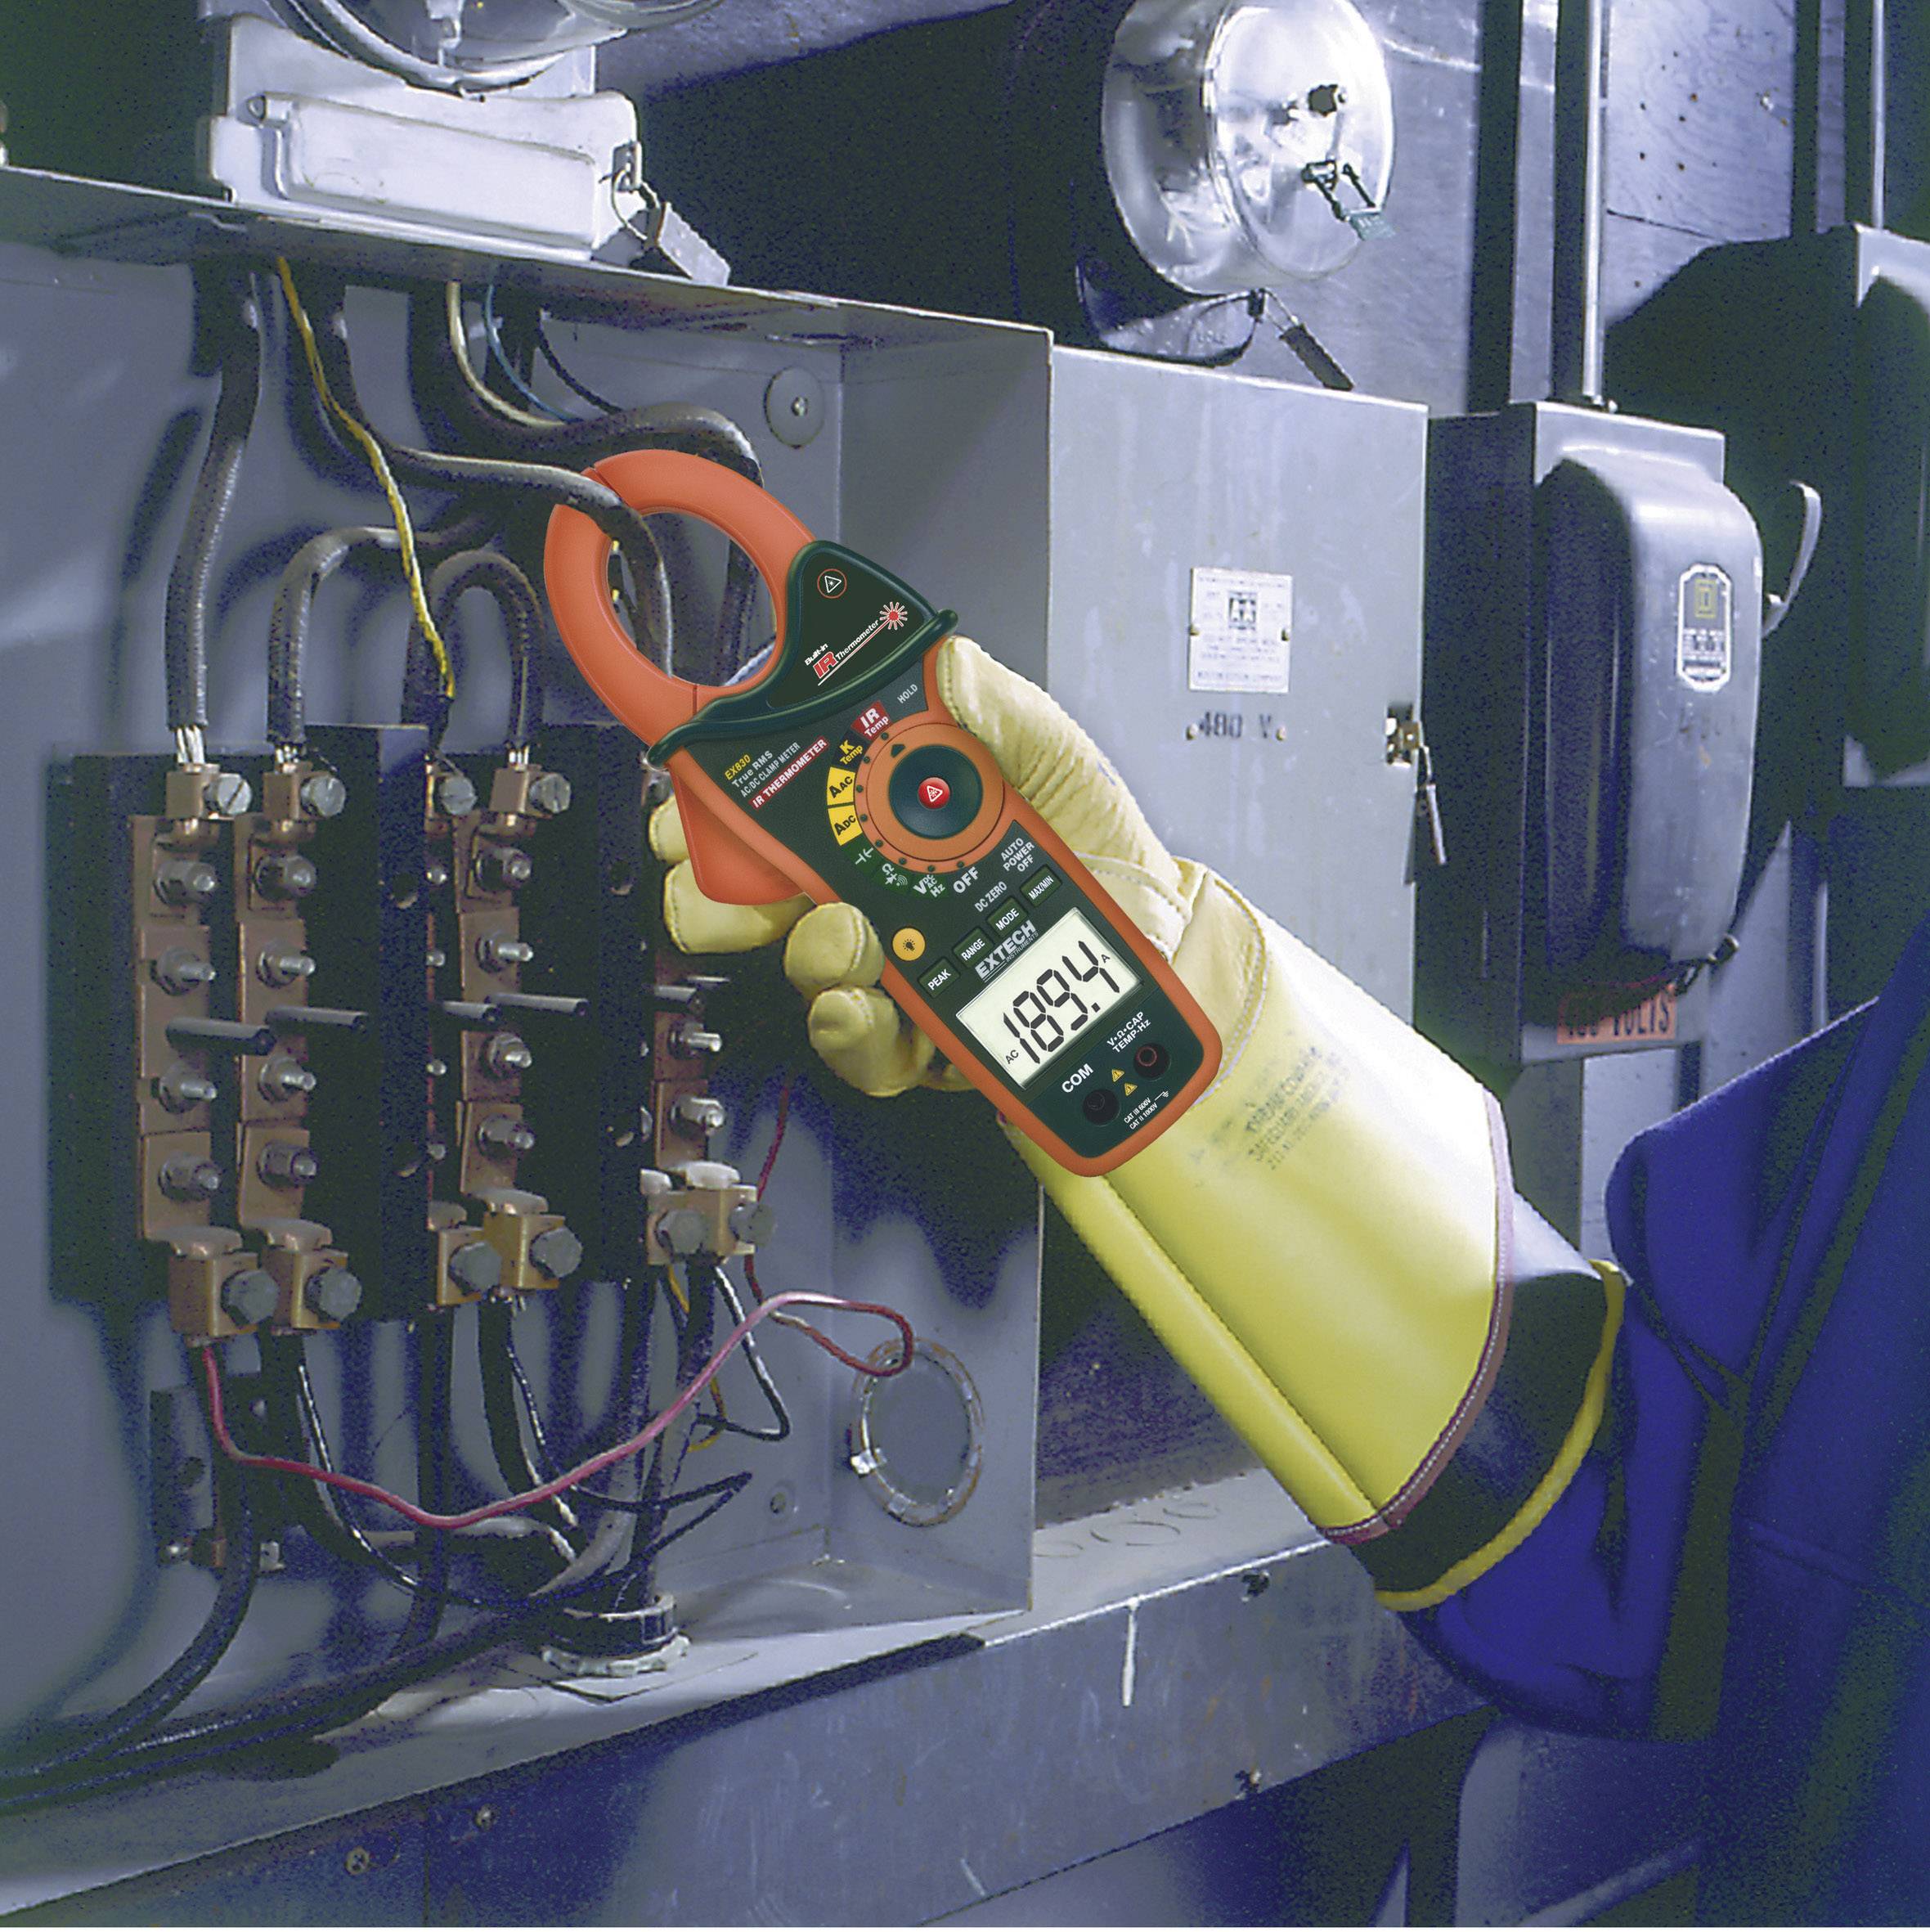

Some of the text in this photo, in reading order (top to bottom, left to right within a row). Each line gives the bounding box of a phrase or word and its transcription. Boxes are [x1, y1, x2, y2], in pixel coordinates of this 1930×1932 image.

[813, 619, 879, 679] IR Thermometer
[897, 683, 918, 704] HOLD
[860, 707, 881, 729] IR
[864, 716, 889, 737] Temp
[839, 739, 855, 756] K
[840, 744, 864, 766] Temp
[725, 754, 752, 780] EX830
[732, 750, 774, 788] True RMS
[740, 742, 801, 798] AC/DC CLAMP METER
[752, 739, 828, 808] IR THERMOMETER
[1000, 837, 1025, 861] AUTO
[1003, 842, 1035, 871] POWER
[1017, 855, 1035, 873] OFF
[930, 883, 946, 898] Hz
[953, 866, 980, 893] OFF
[1028, 875, 1054, 901] MAX/MIN
[974, 881, 1008, 913] DC ZERO
[995, 907, 1020, 932] MODE
[961, 937, 985, 961] RANGE
[974, 919, 1037, 981] EXTECH
[1005, 931, 1039, 963] INSTRUMENTS
[927, 968, 952, 991] PEAK
[1003, 940, 1120, 1065] AC 189.4 A
[1112, 1018, 1151, 1054] TEMP-Hz
[1062, 1063, 1094, 1093] COM
[1124, 1112, 1135, 1124] CAT
[1138, 1097, 1151, 1112] 600V
[1129, 1120, 1140, 1130] CAT
[1142, 1103, 1158, 1118] 1000V
